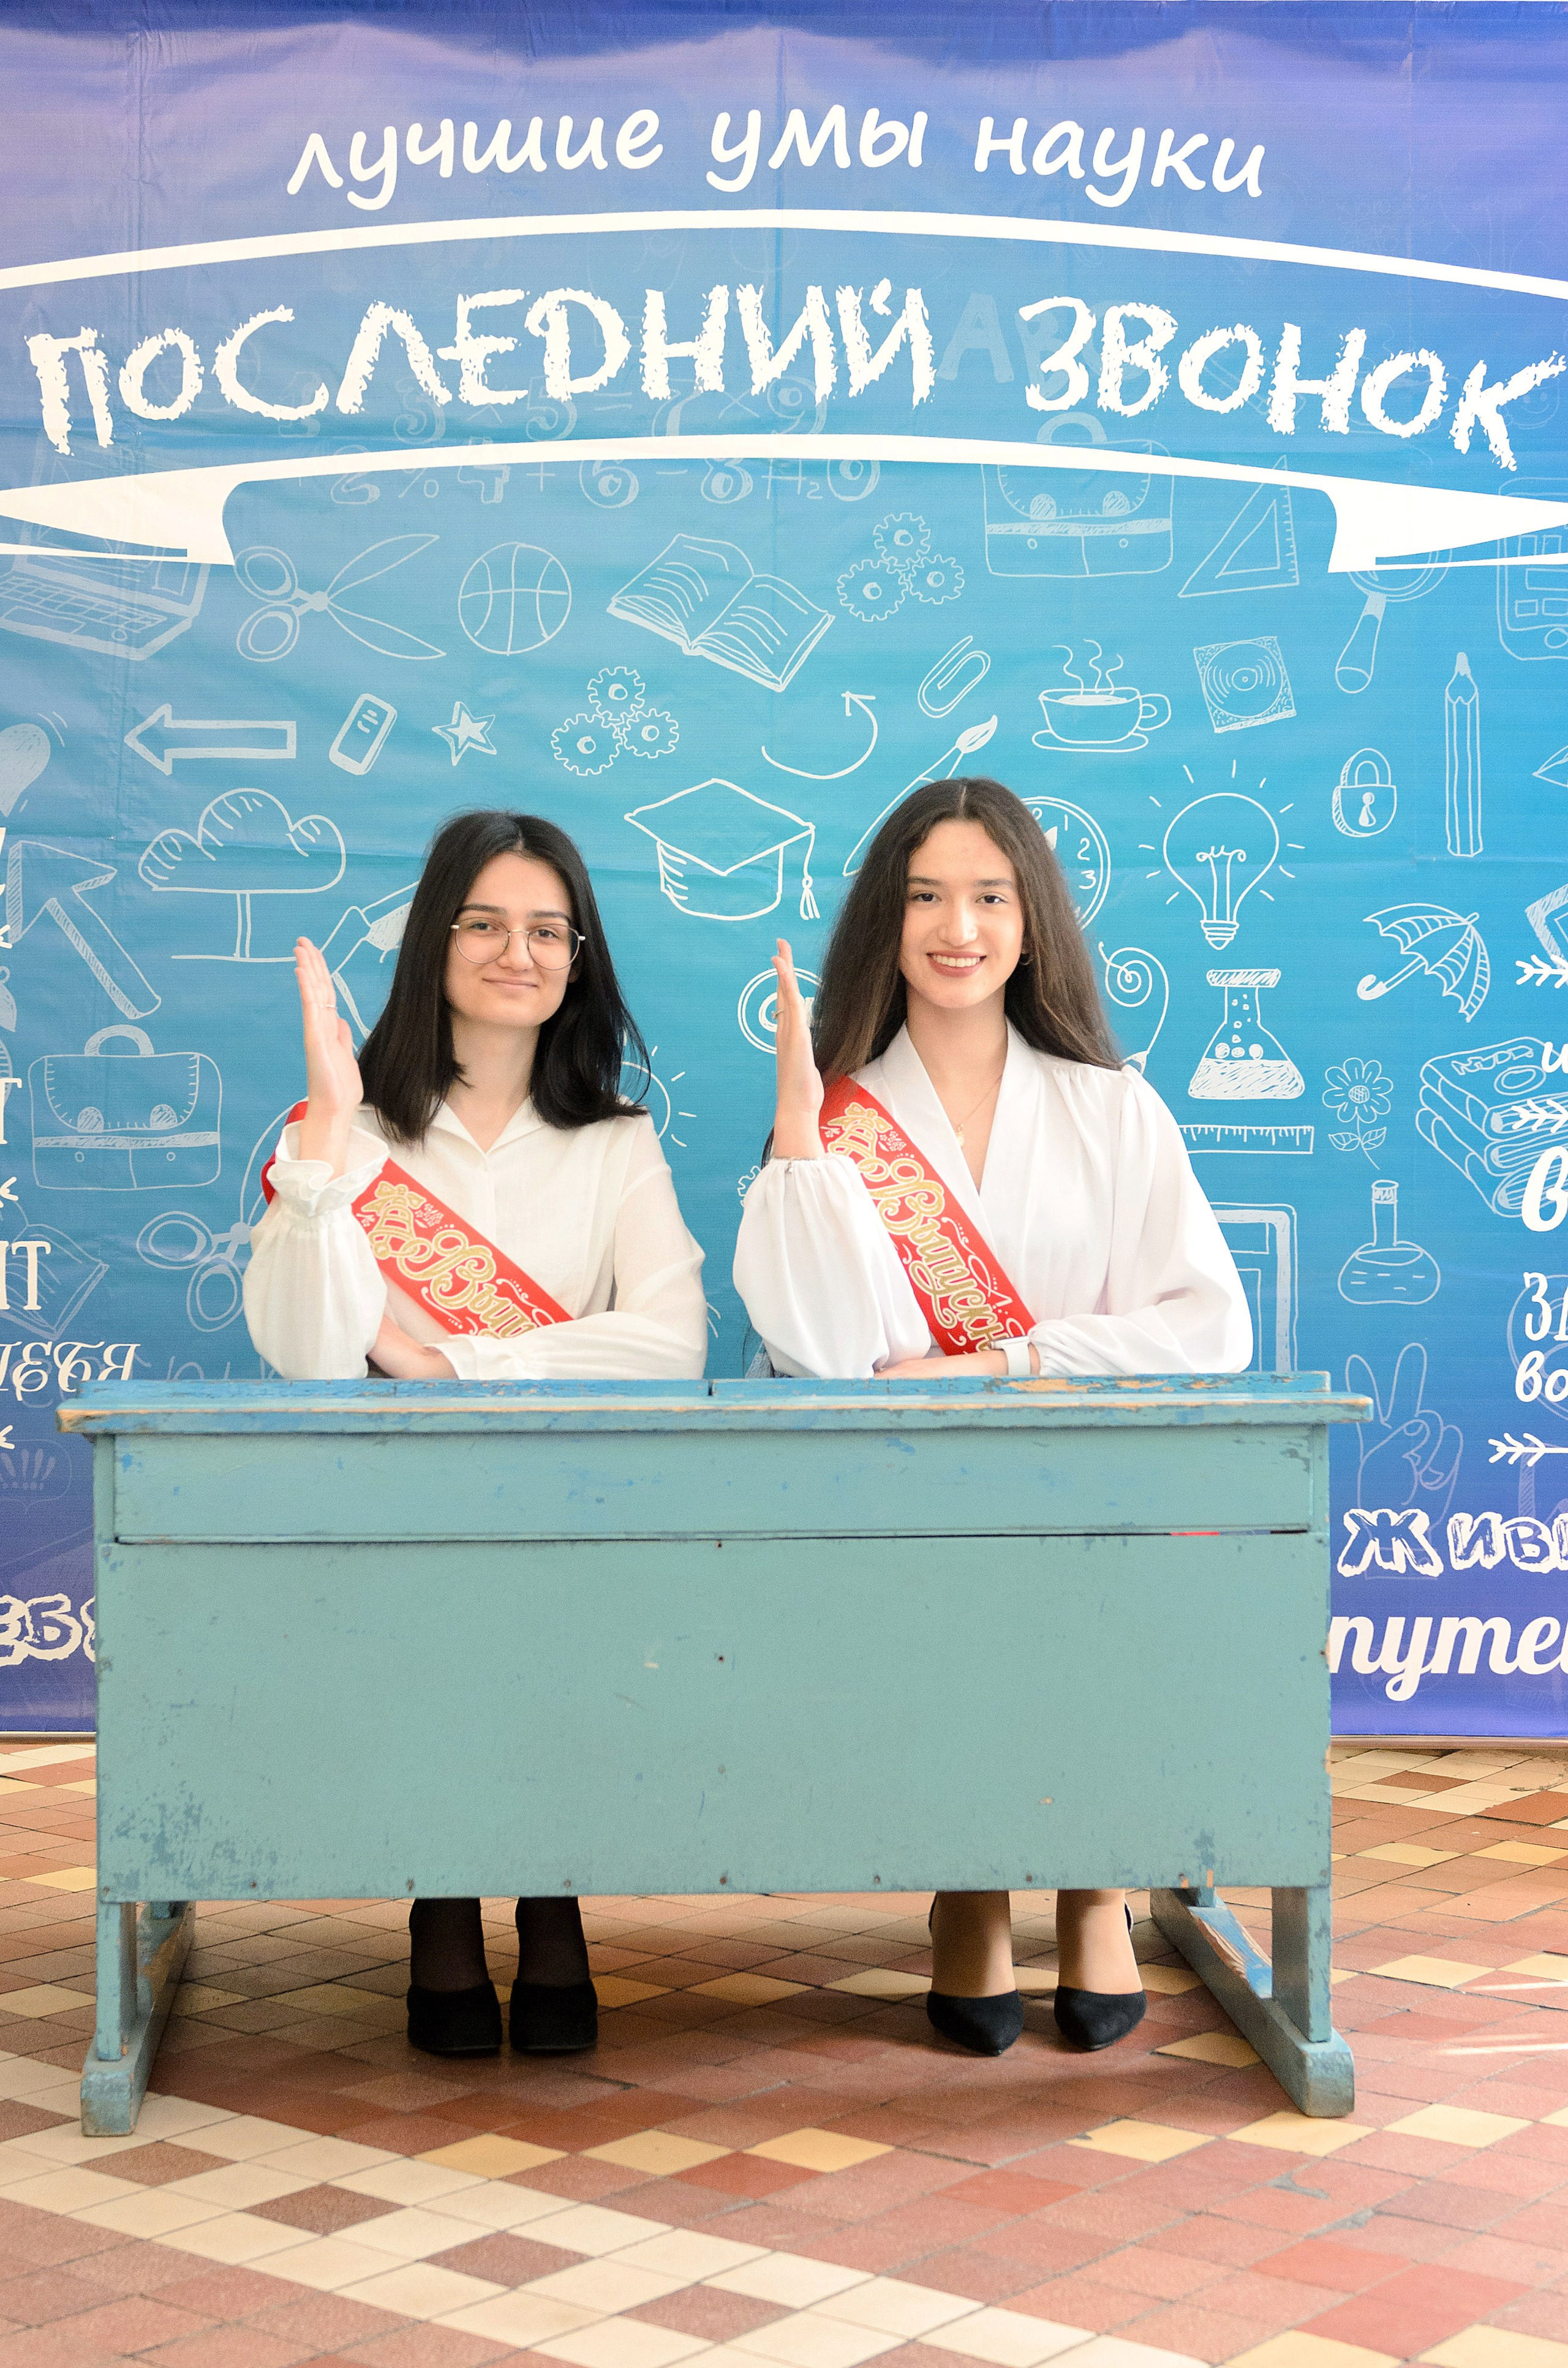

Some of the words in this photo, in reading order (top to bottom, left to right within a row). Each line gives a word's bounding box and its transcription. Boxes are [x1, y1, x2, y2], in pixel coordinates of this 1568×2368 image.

[287, 109, 664, 211] лучшие
[706, 104, 929, 192] умы
[974, 116, 1265, 208] науки
[24, 278, 938, 456] ПОСЛЕДНИЙ
[1018, 295, 1567, 472] ЗВОНОК
[1329, 1616, 1568, 1701] путе
